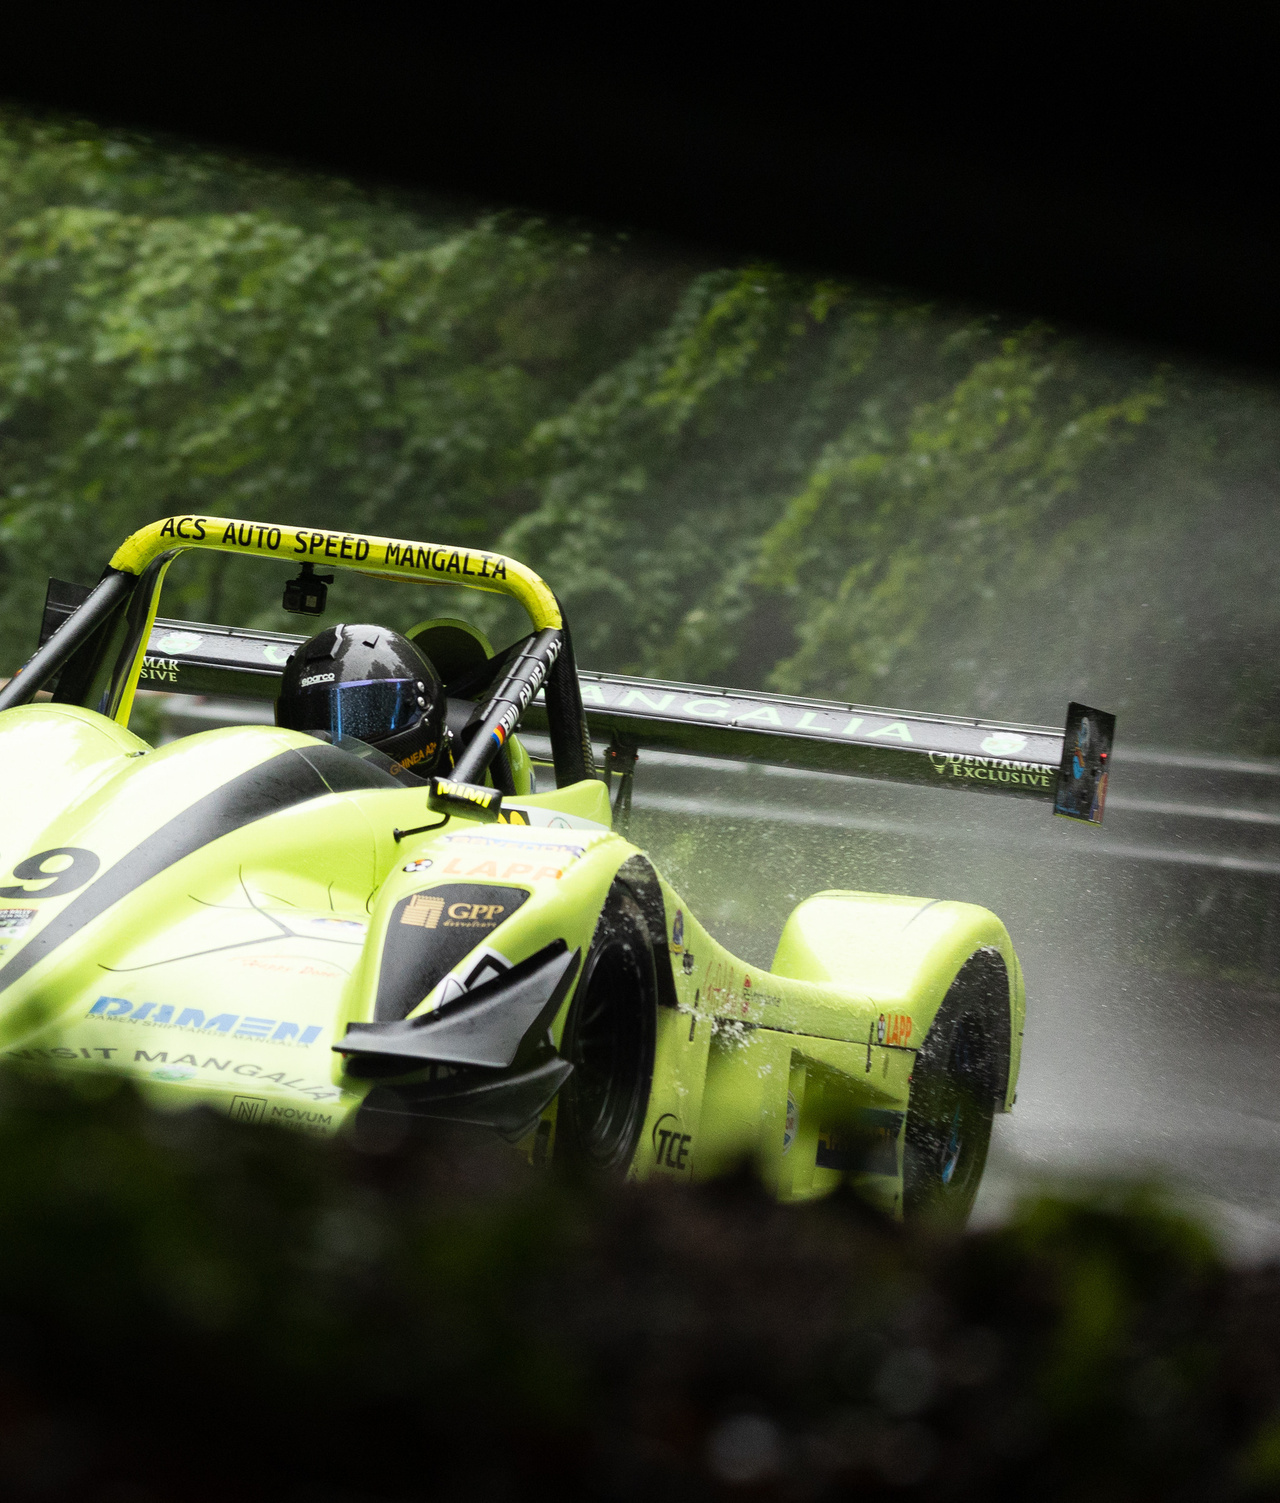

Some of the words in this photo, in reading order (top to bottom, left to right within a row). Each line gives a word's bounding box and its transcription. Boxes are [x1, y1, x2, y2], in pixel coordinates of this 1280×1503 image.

[159, 517, 207, 541] ACS
[221, 522, 281, 551] AUTO
[293, 531, 370, 561] SPEED
[384, 542, 508, 580] MANGALIA
[300, 673, 336, 687] sparco
[579, 684, 914, 743] ANGALIA
[389, 749, 425, 776] GHINEA
[948, 752, 1055, 775] DENTAMAR
[952, 764, 1051, 788] EXCLUSIVE
[437, 781, 493, 808] MIMI
[441, 857, 563, 881] LAPP
[447, 902, 505, 920] GPP
[83, 1012, 139, 1025] DAMEN
[87, 995, 324, 1045] DAMEN
[886, 1013, 912, 1047] LAPP
[133, 1050, 337, 1102] MANGALIA
[271, 1105, 333, 1126] NOVUM
[657, 1128, 691, 1171] TCE
